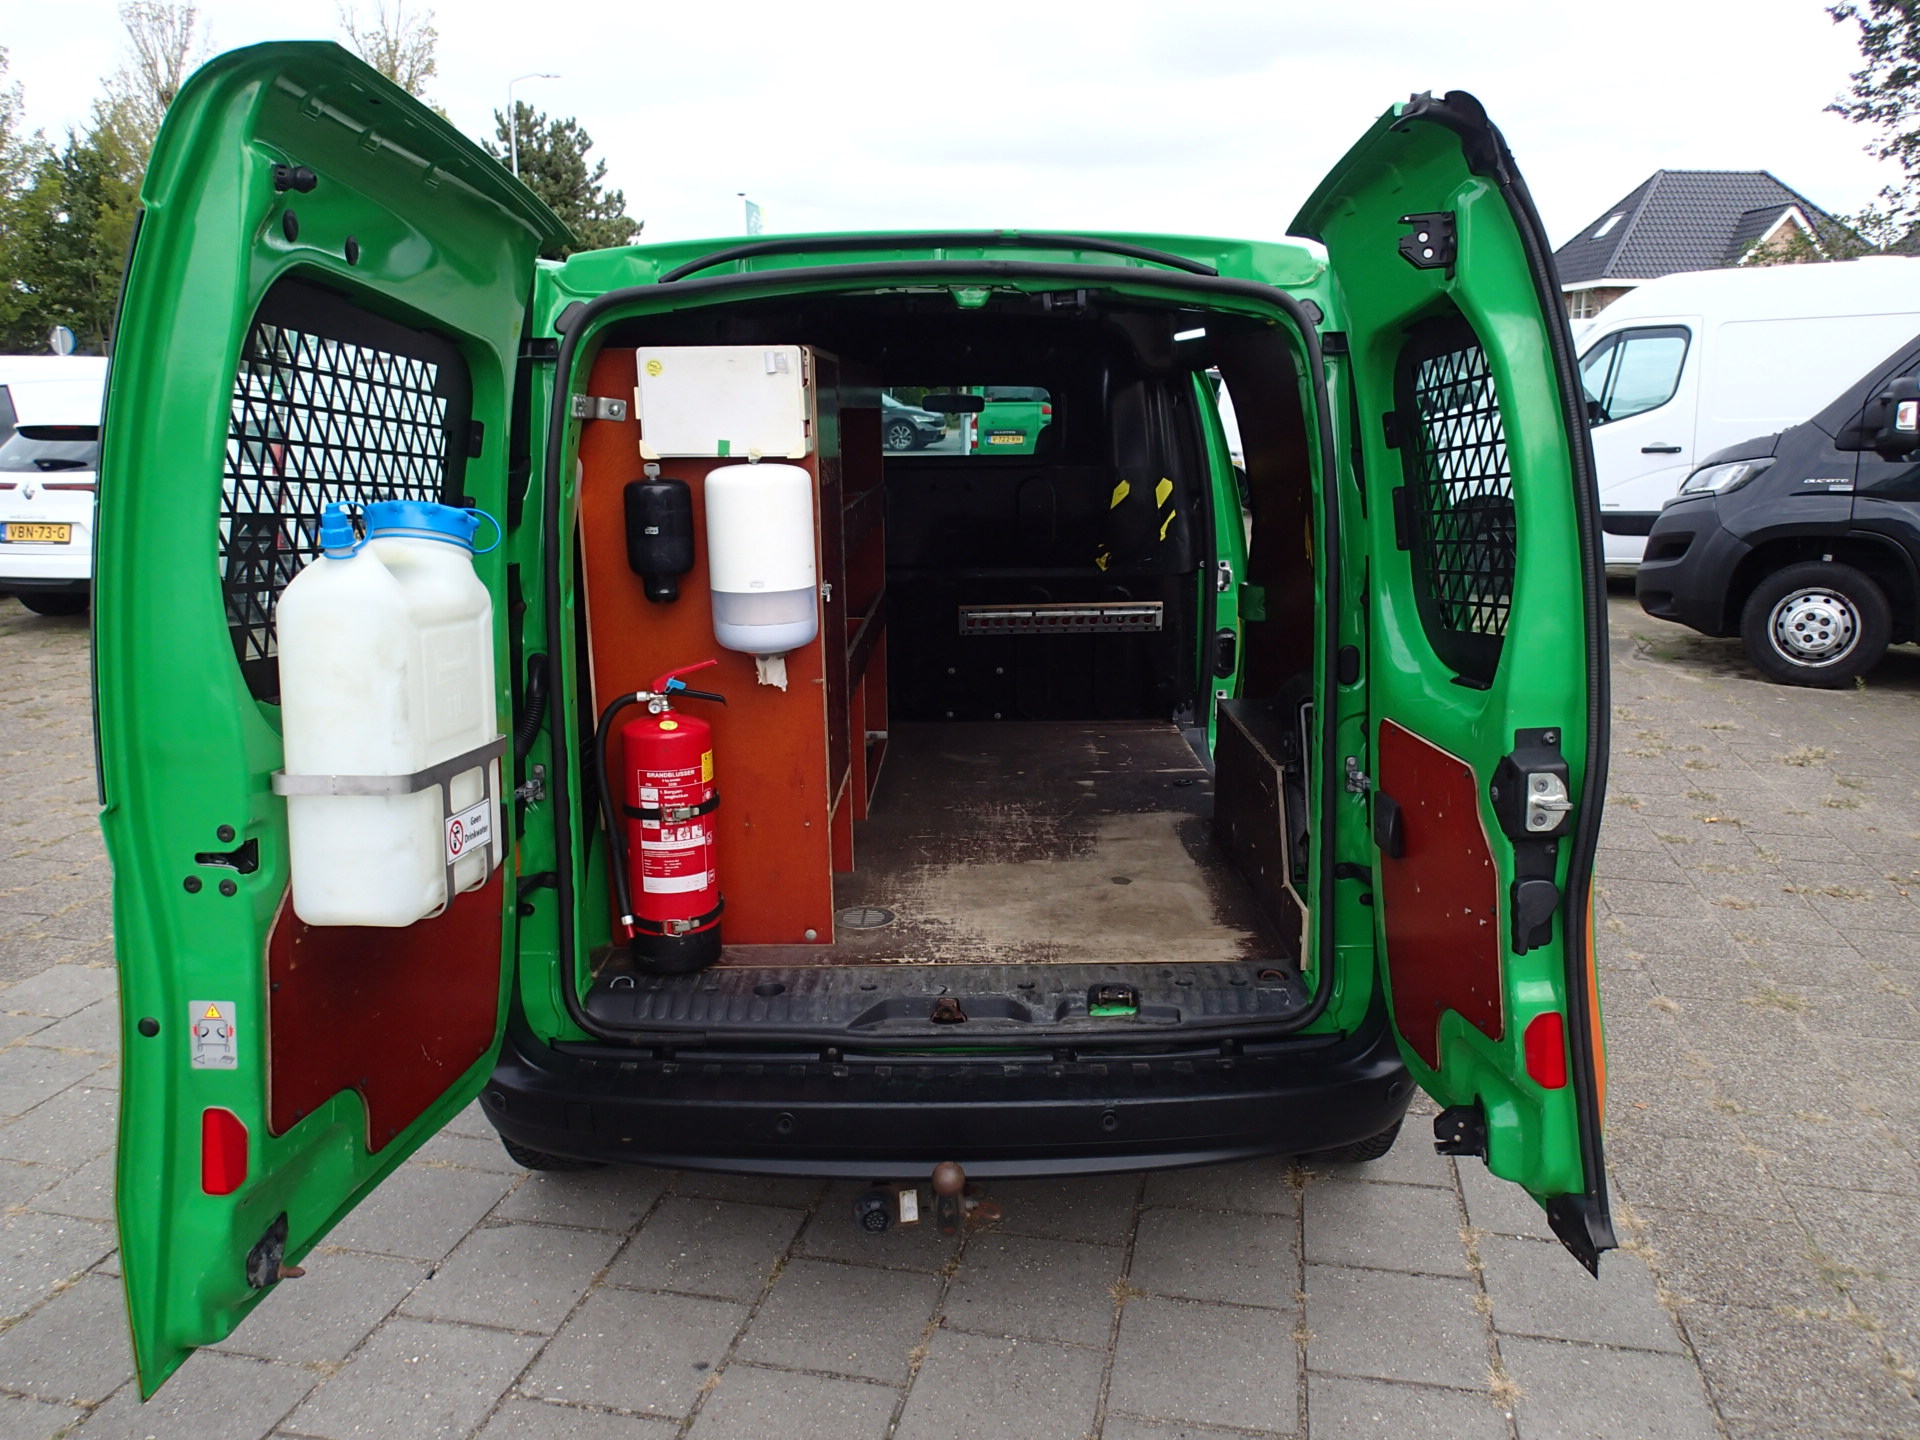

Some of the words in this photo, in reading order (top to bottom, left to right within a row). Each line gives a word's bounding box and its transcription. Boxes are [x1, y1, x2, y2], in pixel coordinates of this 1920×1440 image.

[10, 526, 65, 539] VBN-73-G
[470, 814, 482, 826] Geen
[464, 825, 489, 843] Drinkwater
